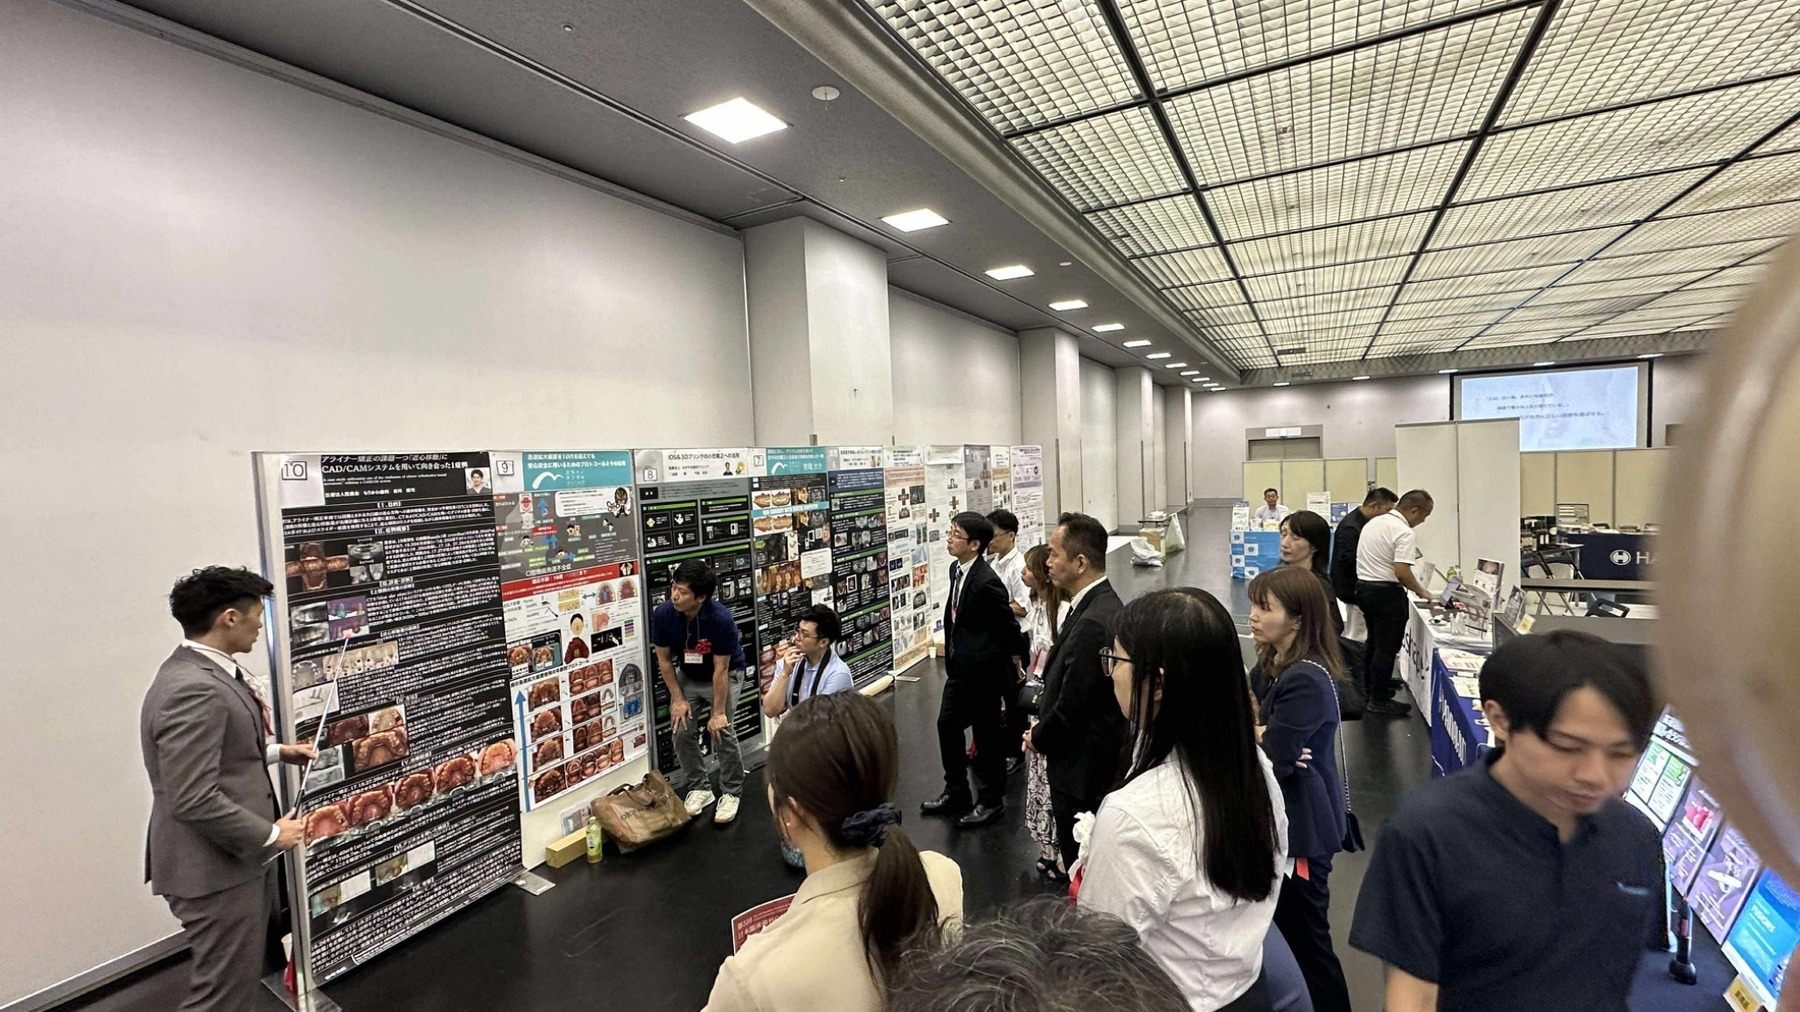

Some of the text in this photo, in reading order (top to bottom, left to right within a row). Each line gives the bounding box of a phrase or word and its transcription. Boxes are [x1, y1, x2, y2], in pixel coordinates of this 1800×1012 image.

[284, 463, 305, 477] 10
[501, 461, 508, 474] 9
[647, 470, 653, 479] 8
